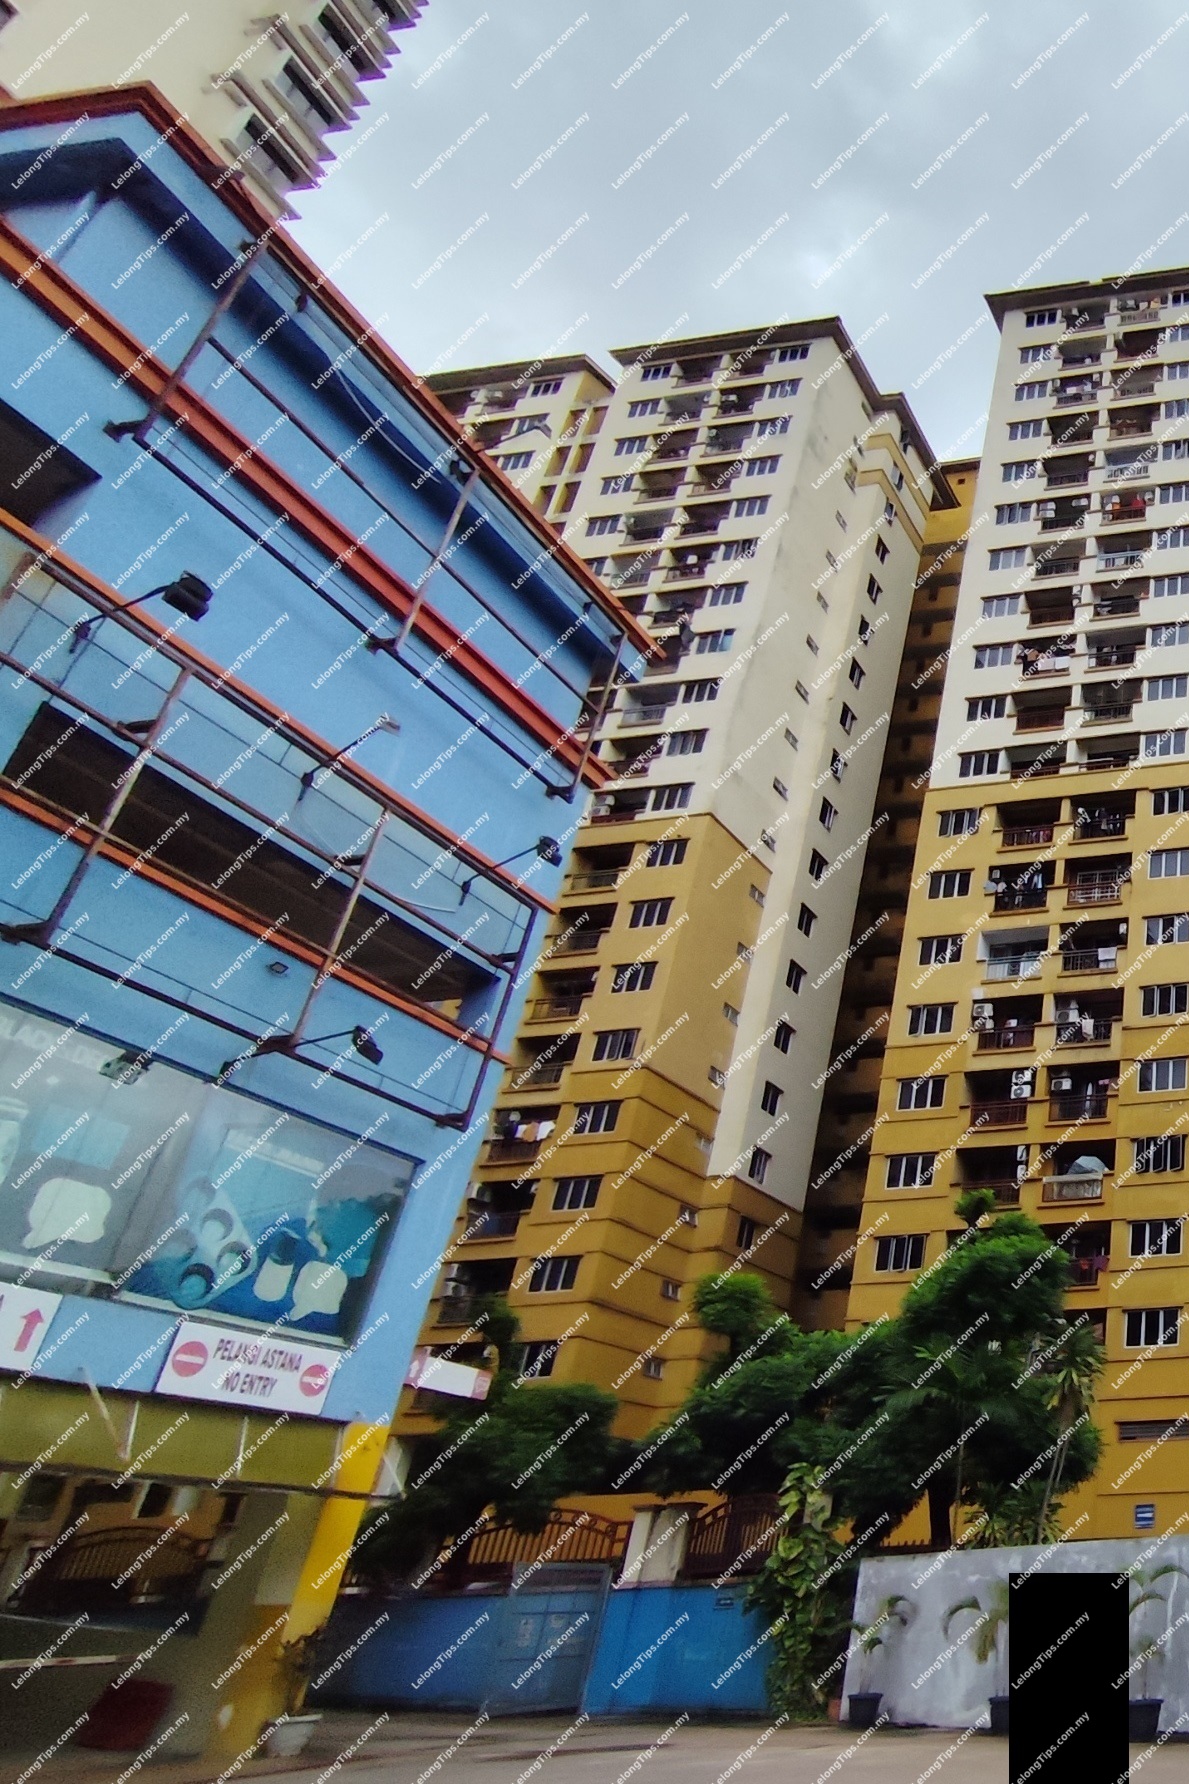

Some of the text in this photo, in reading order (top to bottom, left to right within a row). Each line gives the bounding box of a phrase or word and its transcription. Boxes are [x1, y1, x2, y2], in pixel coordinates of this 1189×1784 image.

[212, 1338, 304, 1373] PELANGI ASTANA
[221, 1371, 279, 1398] NO ENTRY
